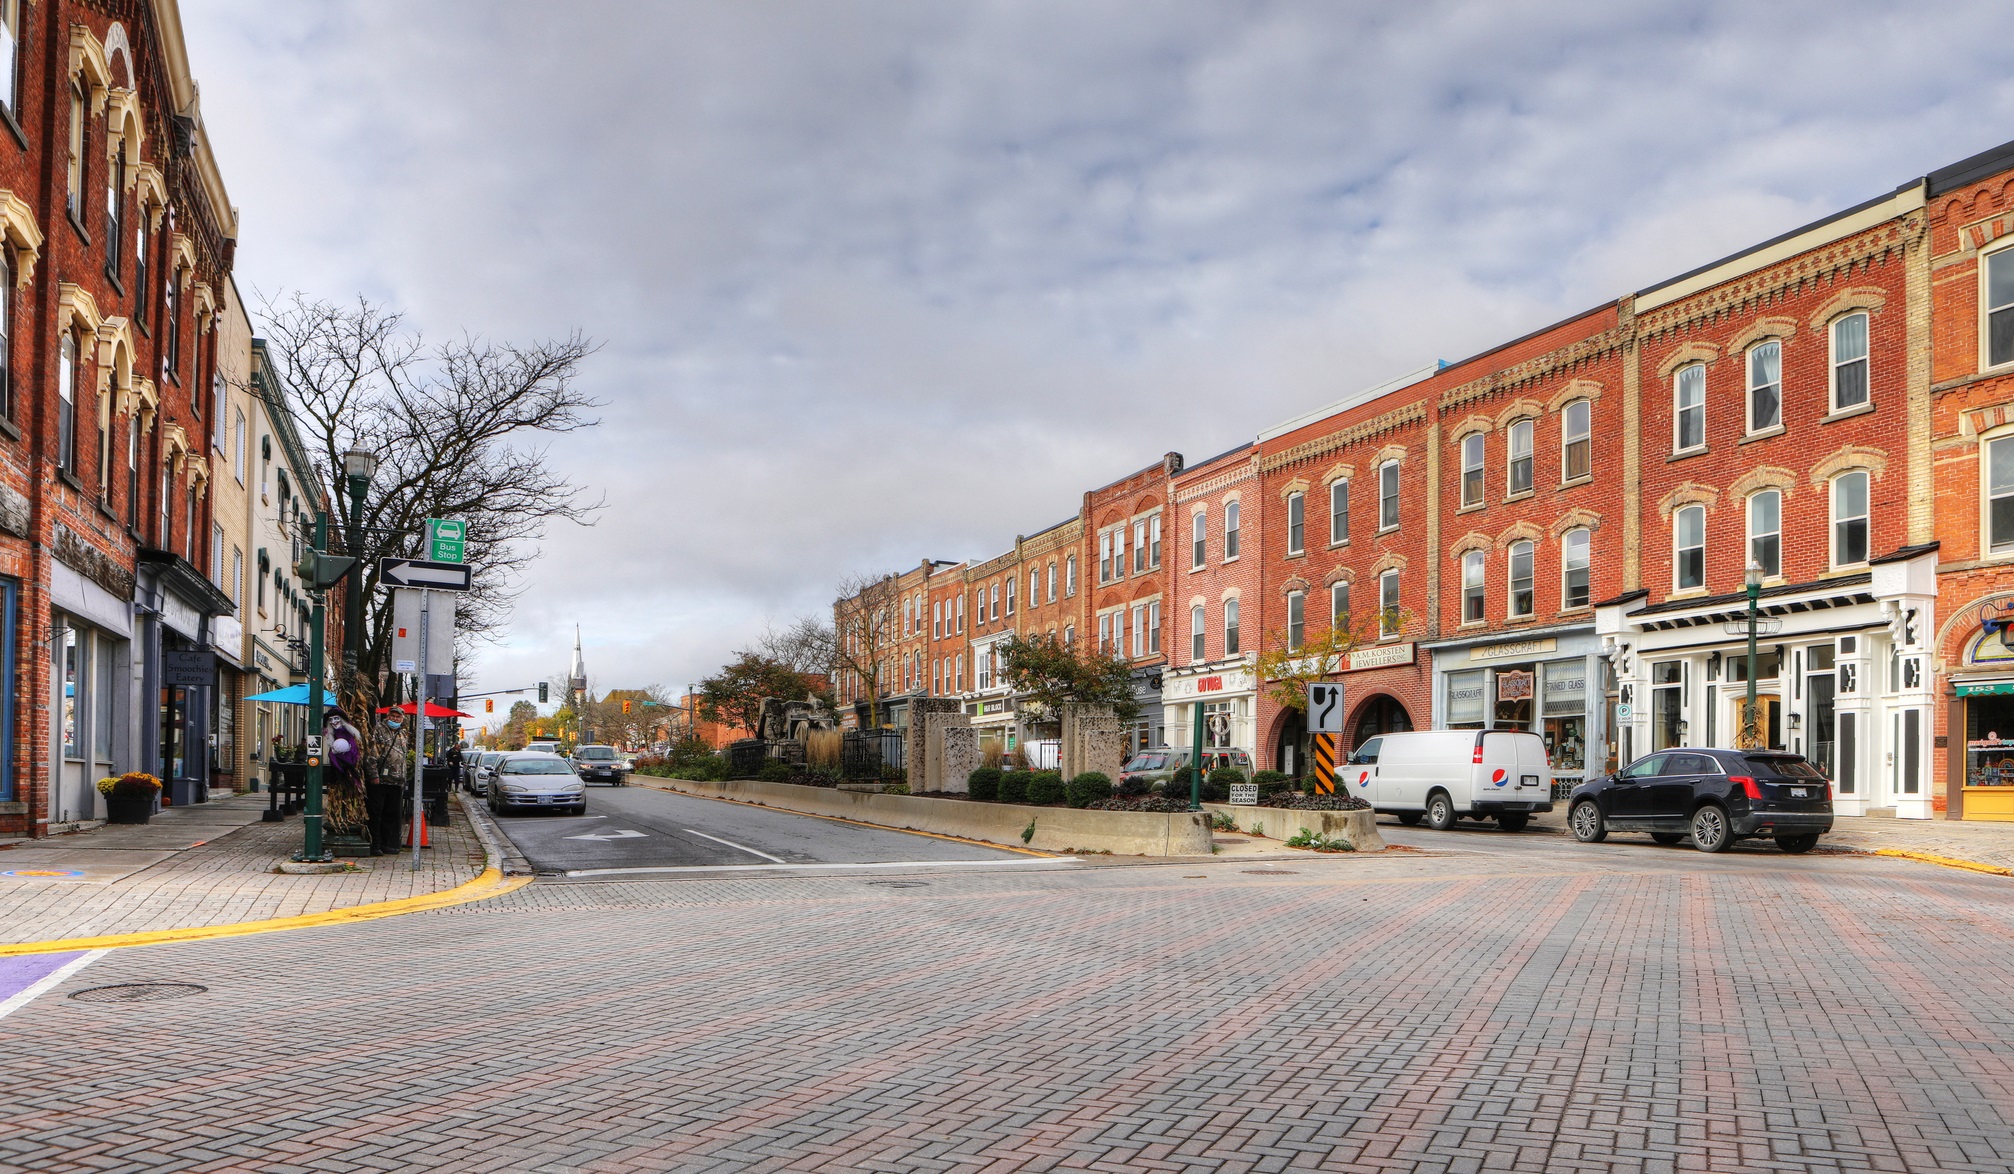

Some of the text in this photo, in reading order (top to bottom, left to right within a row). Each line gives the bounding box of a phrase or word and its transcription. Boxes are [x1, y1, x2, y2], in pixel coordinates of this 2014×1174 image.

[440, 543, 456, 551] Bus
[438, 551, 457, 560] Stop
[1371, 646, 1405, 658] KORSTEN
[1487, 641, 1542, 657] GLASSCRAFT
[179, 653, 202, 662] Cafe
[1355, 655, 1397, 668] JEWELLERS
[168, 664, 213, 672] Smoothies
[176, 673, 204, 682] Eatery
[1568, 680, 1585, 689] GLASS
